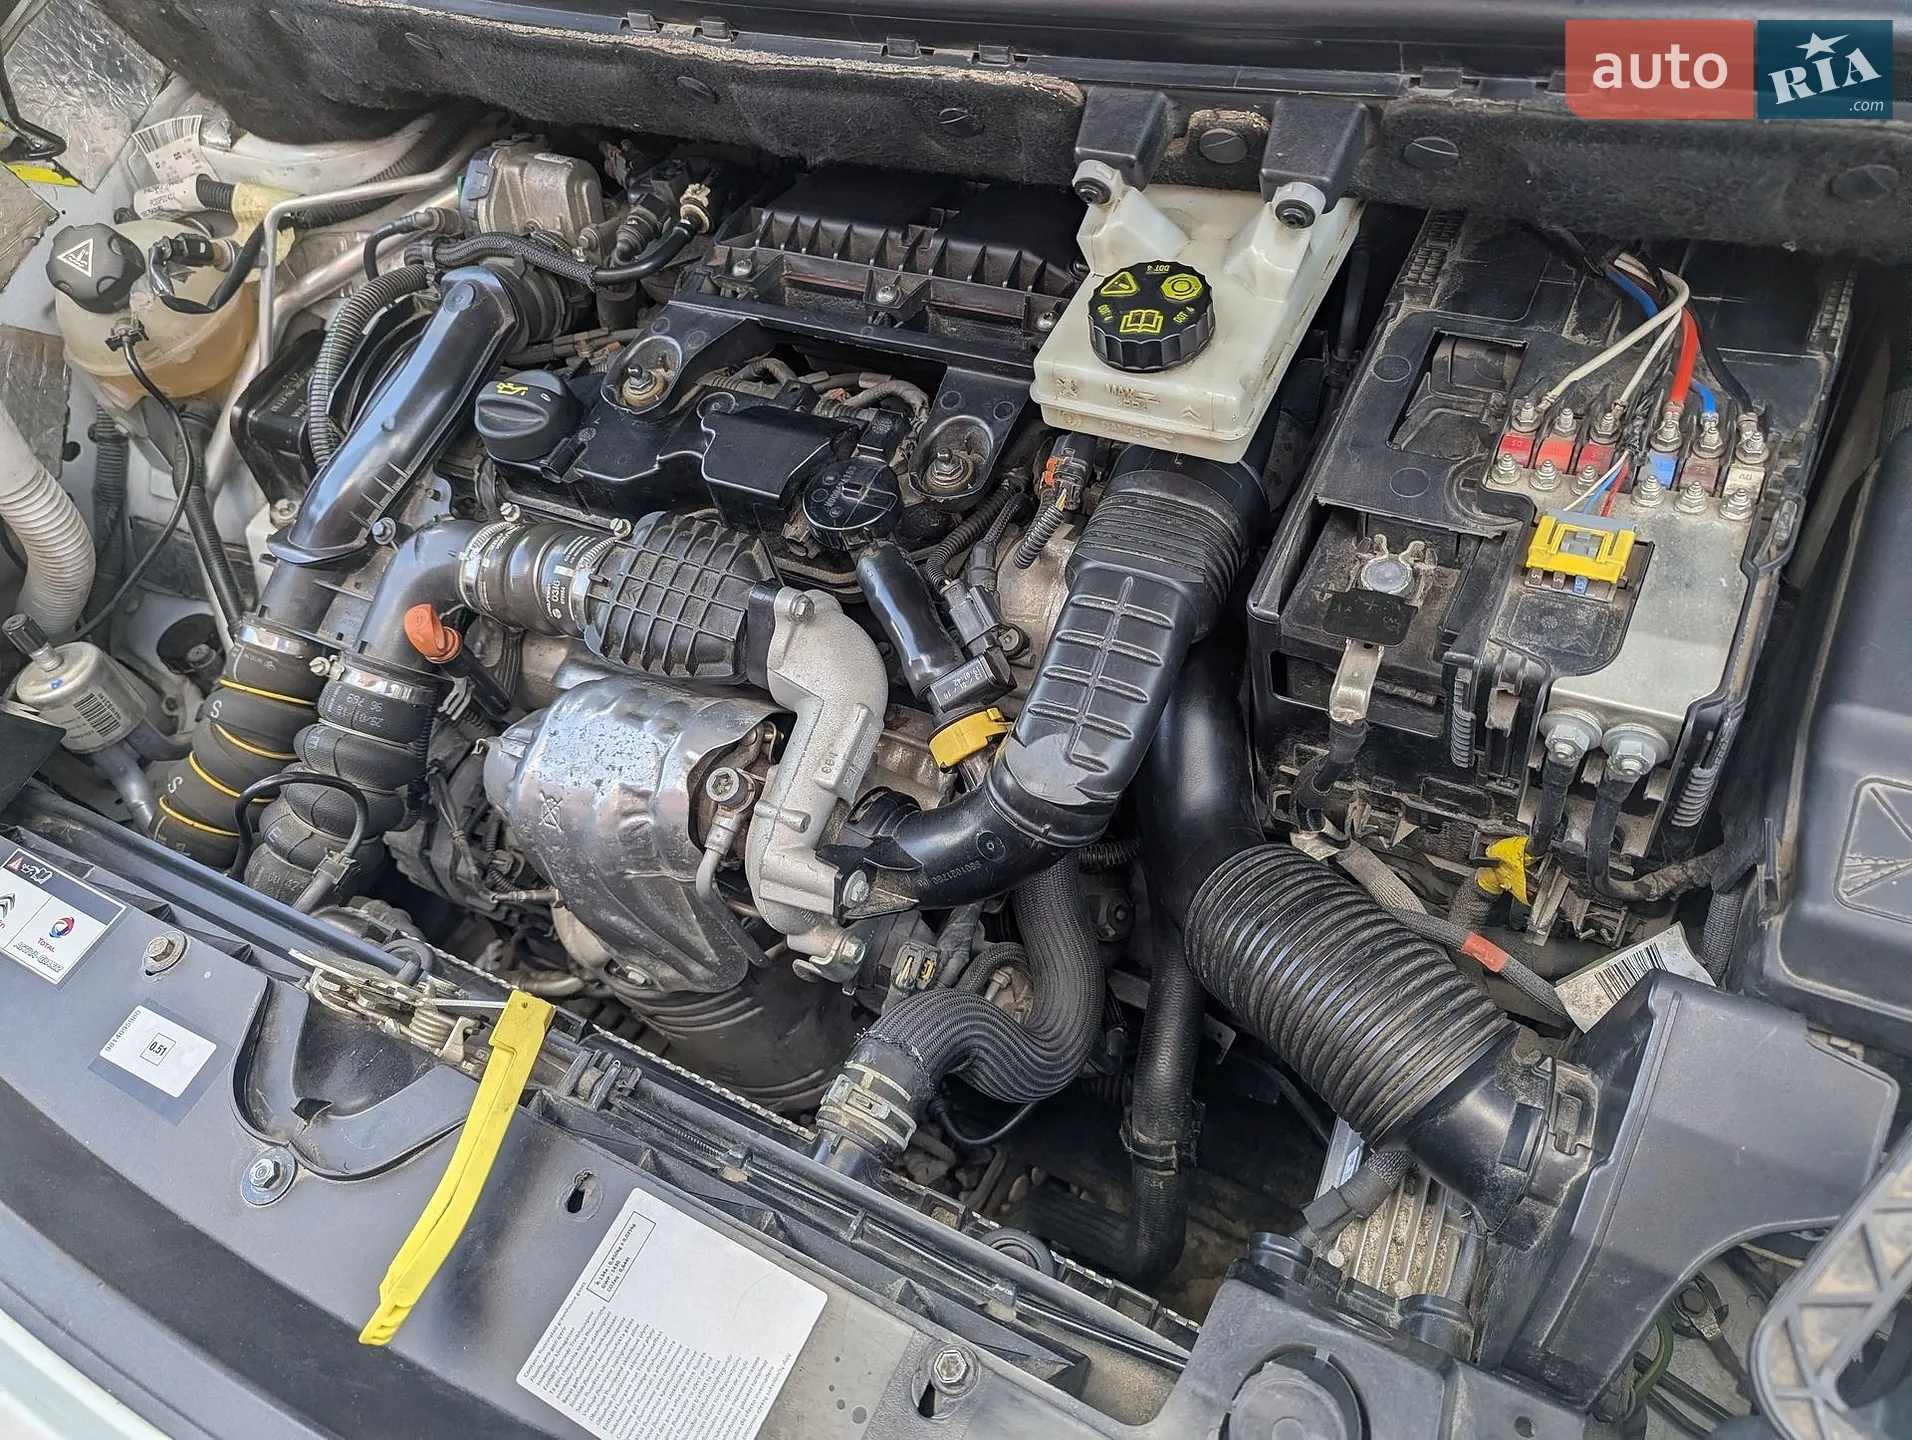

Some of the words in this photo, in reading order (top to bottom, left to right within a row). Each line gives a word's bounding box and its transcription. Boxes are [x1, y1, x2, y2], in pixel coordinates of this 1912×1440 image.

[1106, 383, 1134, 399] MAX
[38, 937, 55, 953] TOTAL
[149, 1040, 168, 1058] 0.51
